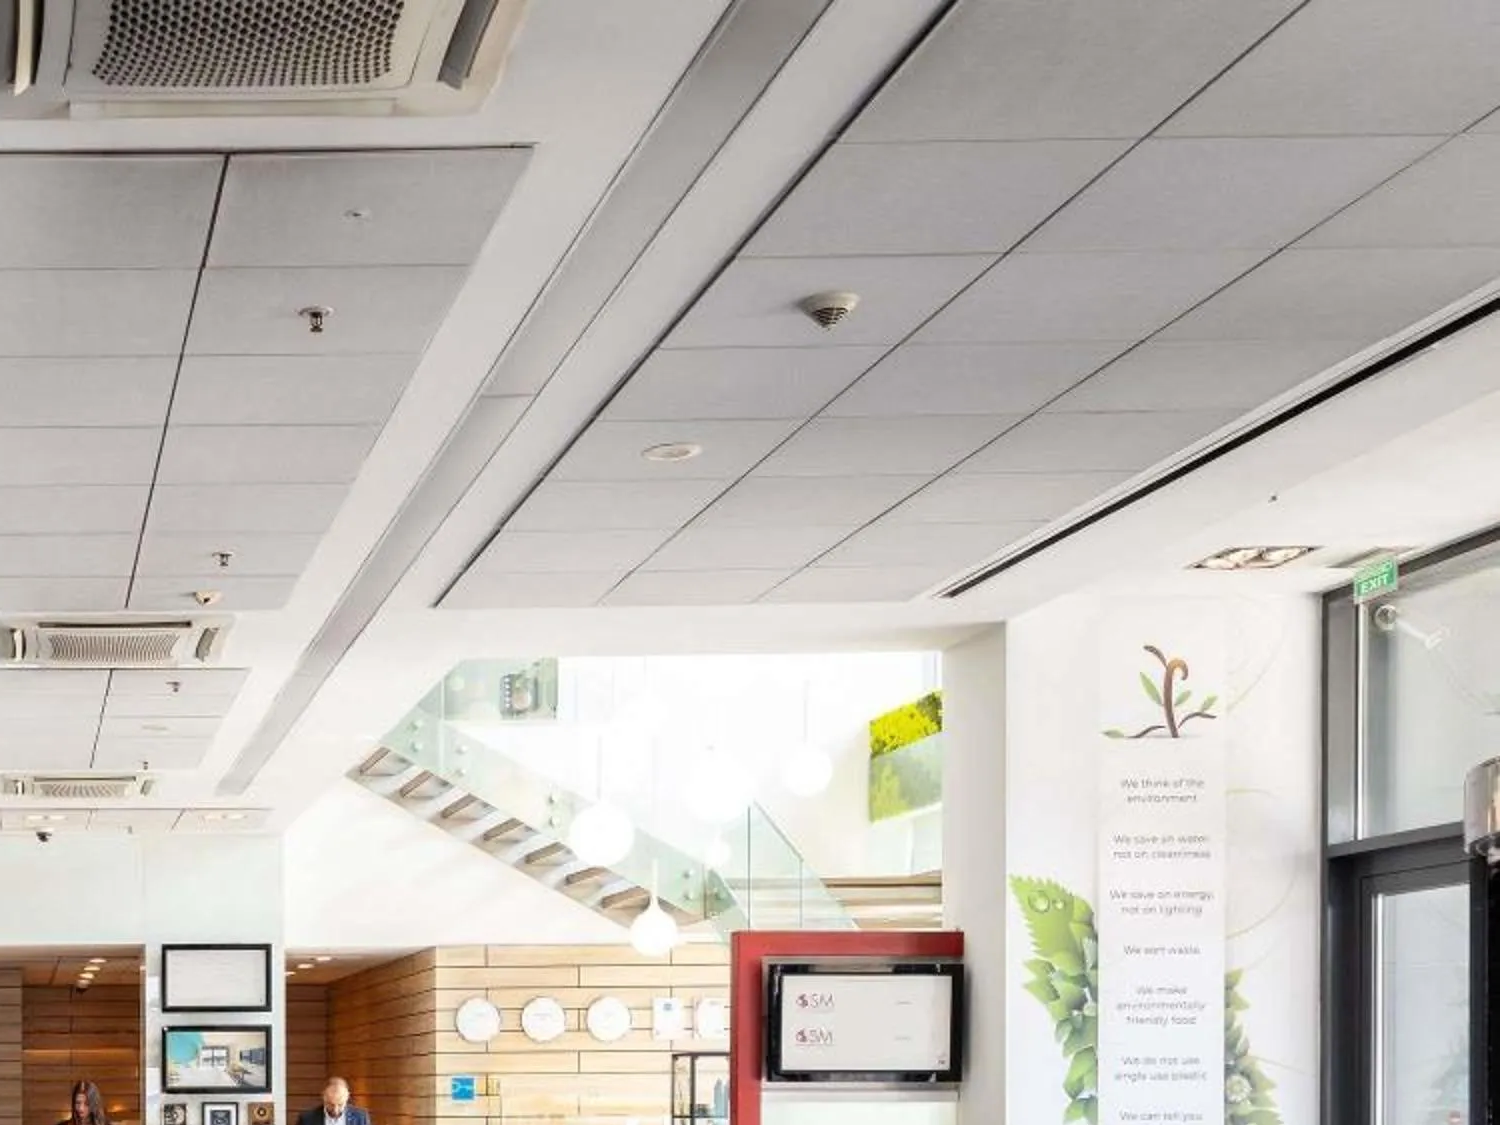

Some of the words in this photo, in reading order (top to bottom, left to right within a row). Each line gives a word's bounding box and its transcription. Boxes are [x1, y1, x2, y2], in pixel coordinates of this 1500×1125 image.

[1360, 573, 1388, 594] EXIT
[1121, 778, 1139, 789] We
[1114, 834, 1132, 845] We
[1109, 888, 1128, 900] We
[1123, 944, 1142, 956] We
[1125, 1015, 1169, 1028] friendly
[1121, 1055, 1141, 1066] We
[1119, 1110, 1139, 1121] We
